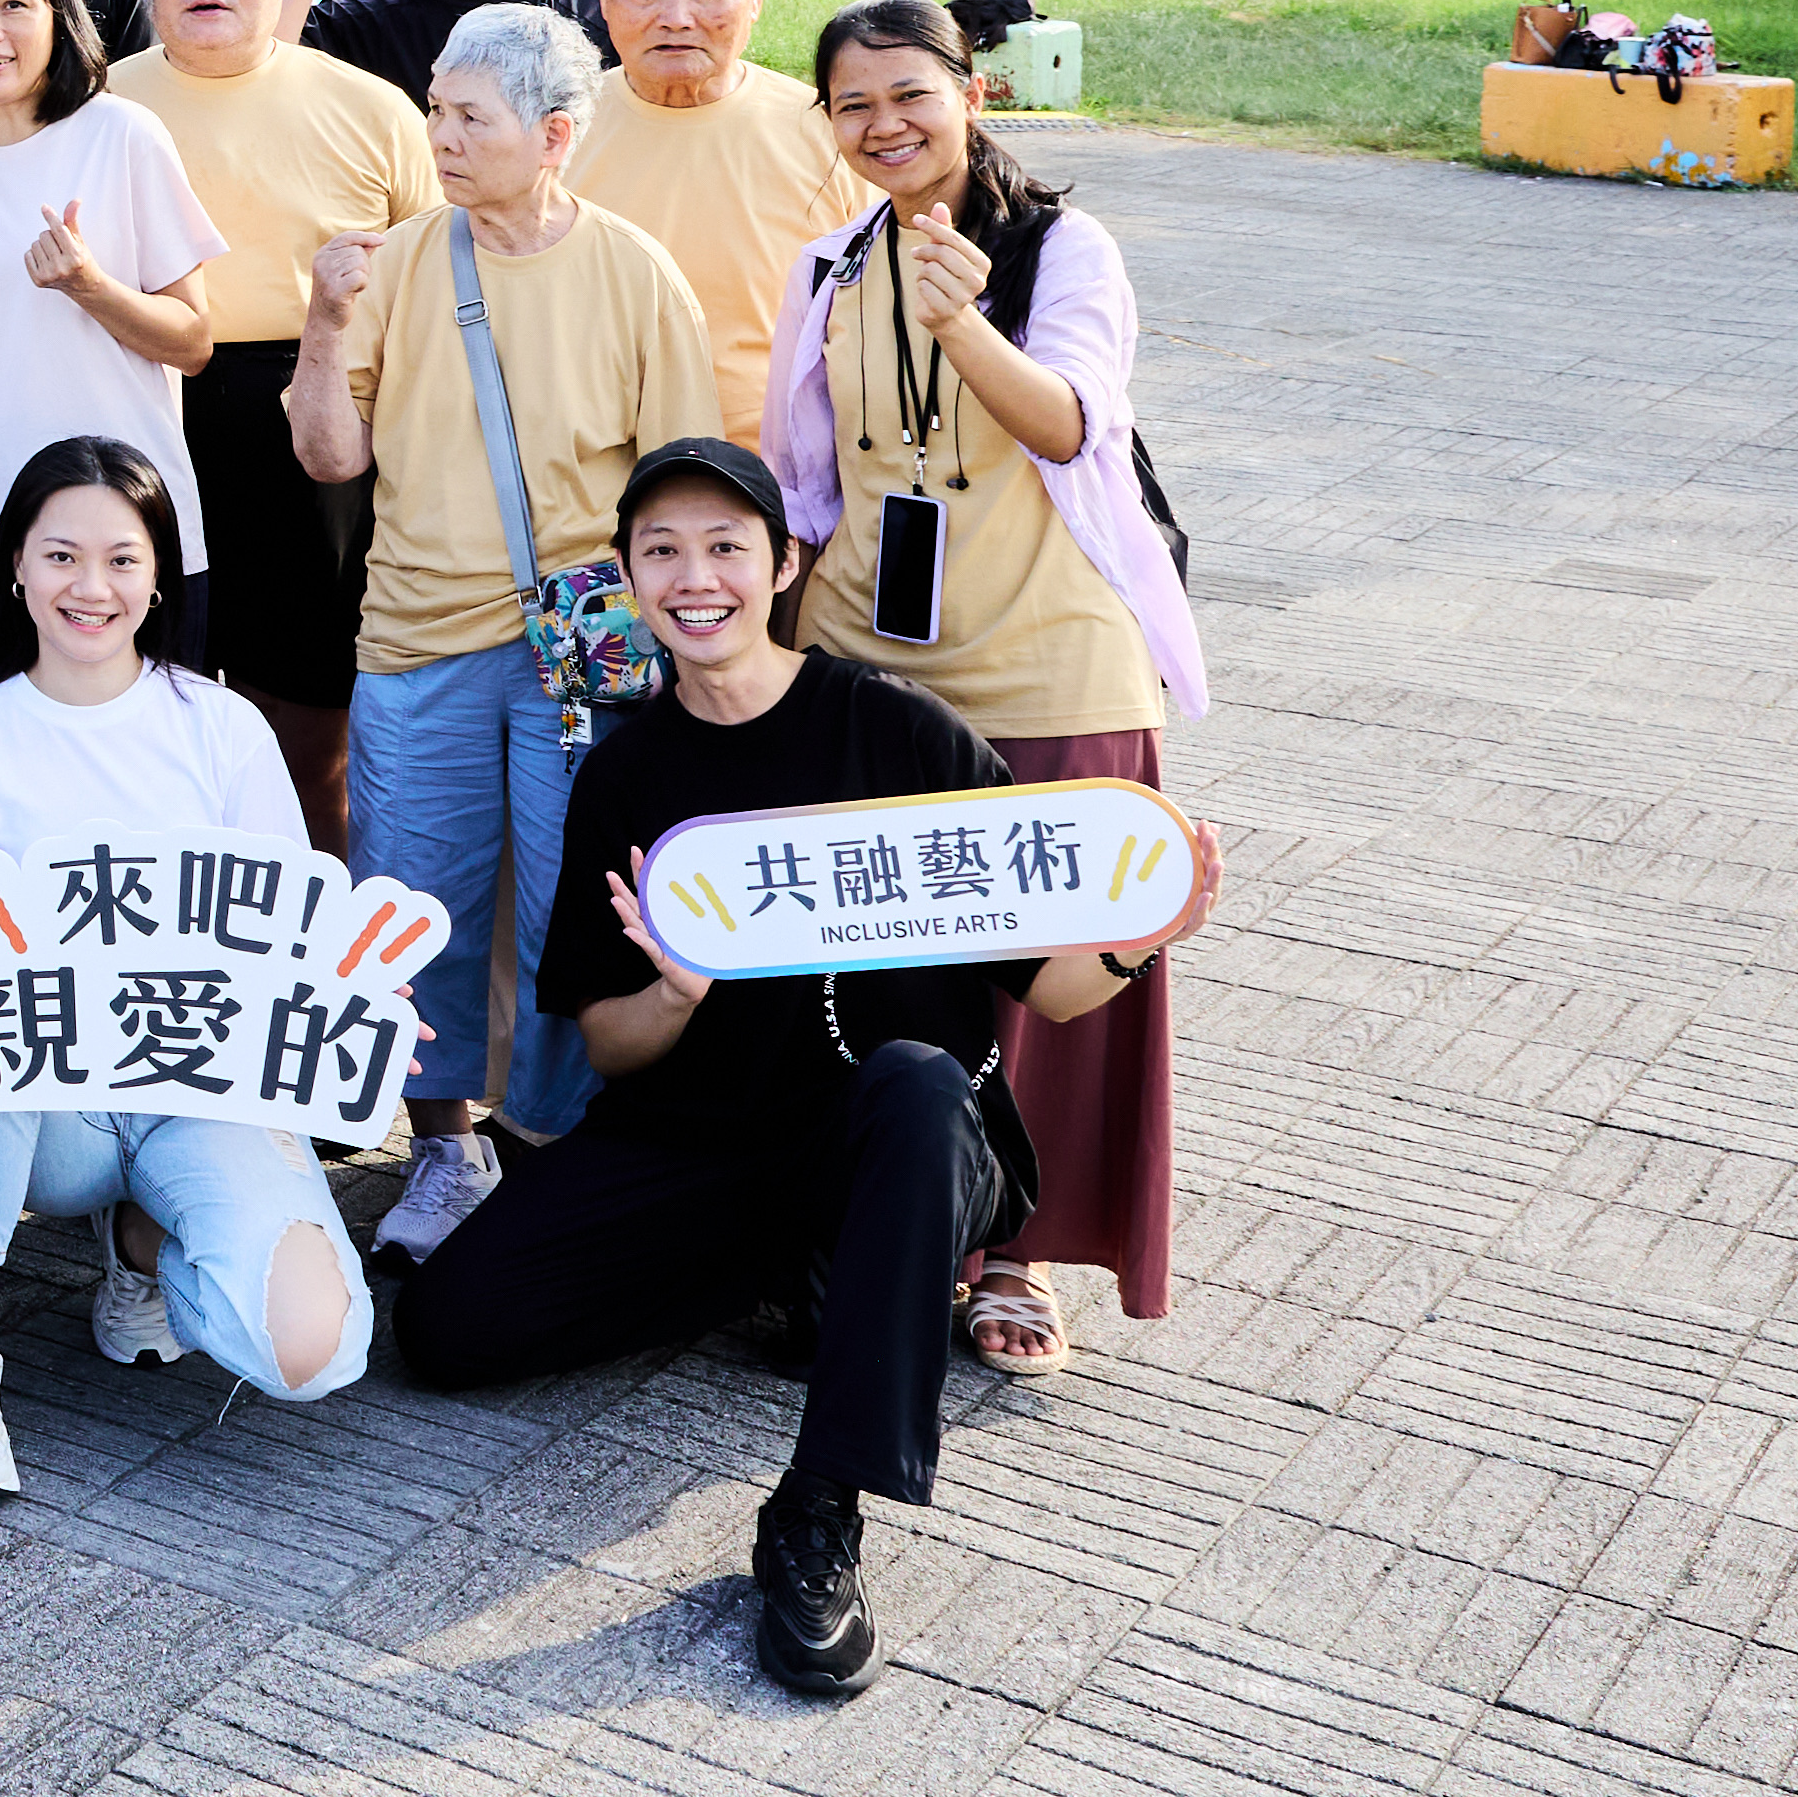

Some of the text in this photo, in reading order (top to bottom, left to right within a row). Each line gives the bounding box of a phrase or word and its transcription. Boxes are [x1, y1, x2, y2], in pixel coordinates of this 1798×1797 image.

[744, 818, 1082, 917] 共融藝術
[820, 911, 1019, 945] INCLUSIVE ARTS
